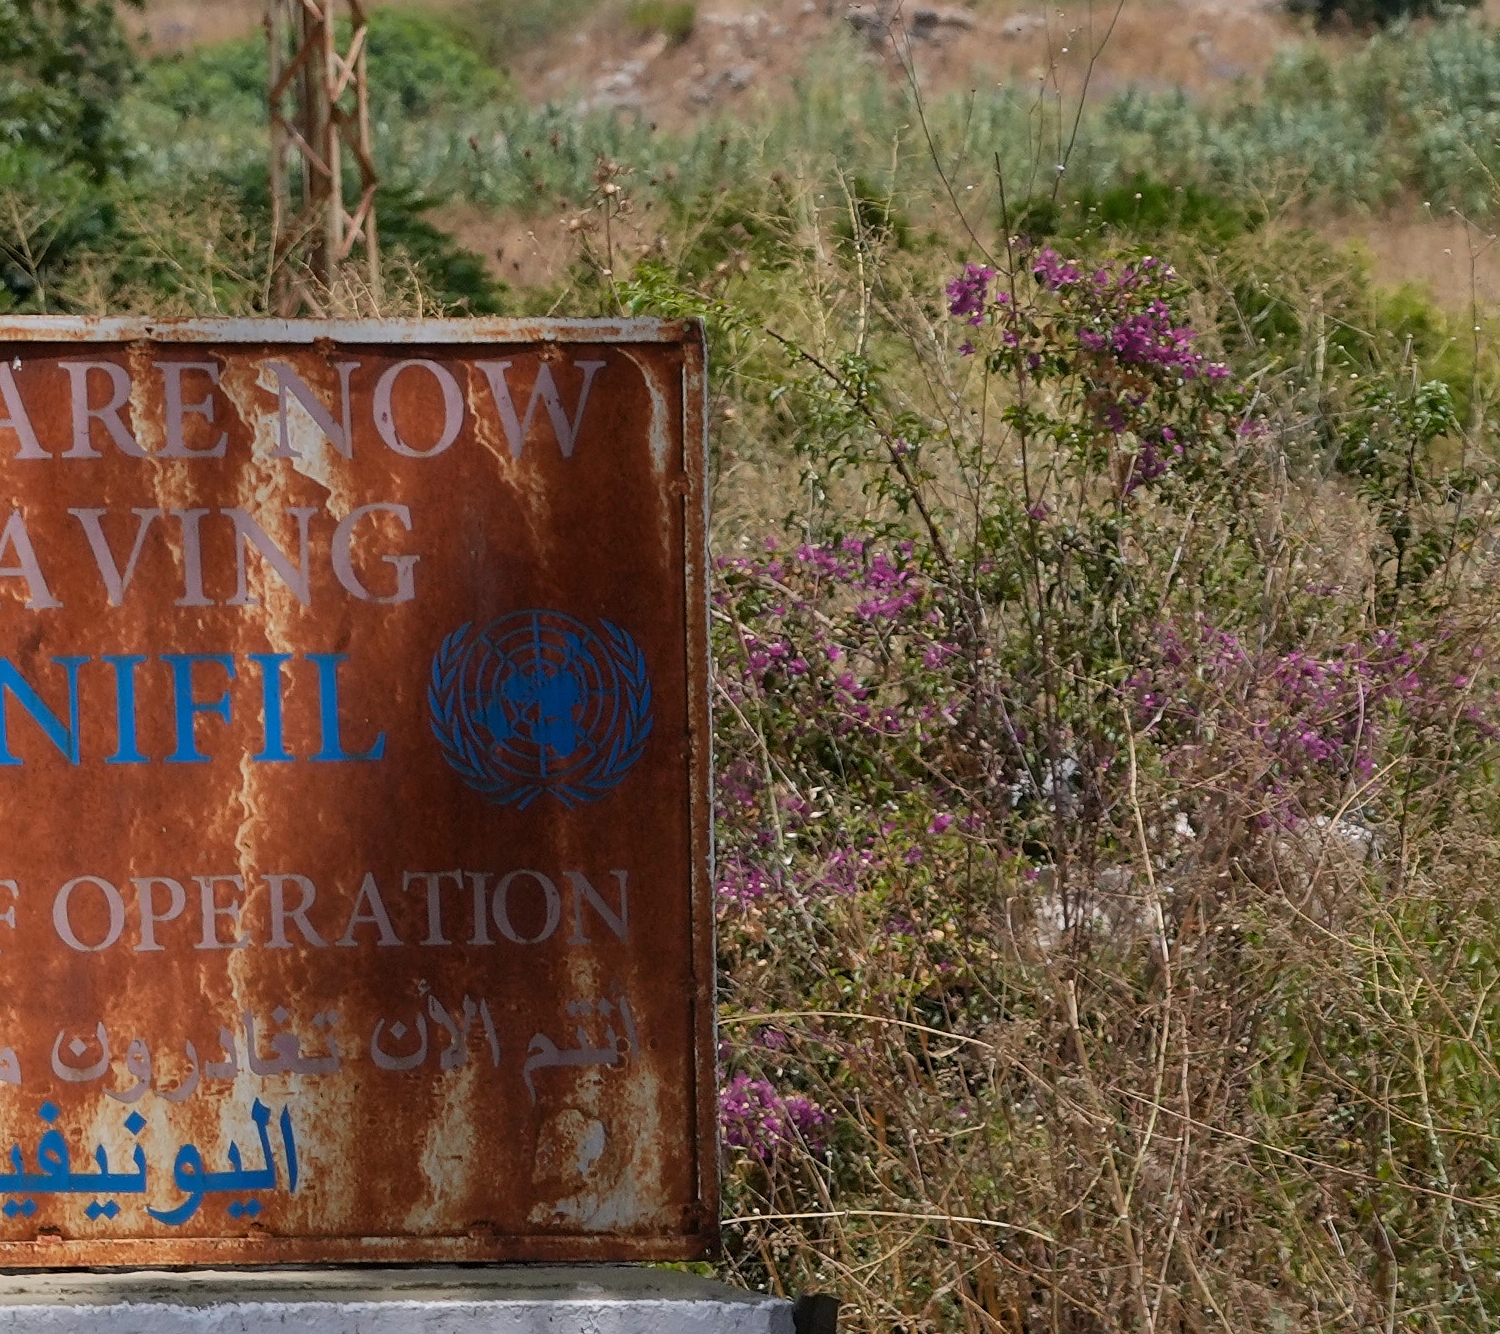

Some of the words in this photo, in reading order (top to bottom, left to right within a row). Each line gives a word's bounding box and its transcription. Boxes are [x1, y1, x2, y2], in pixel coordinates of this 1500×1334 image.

[254, 358, 606, 460] NOW
[52, 868, 630, 952] OPERATION
[51, 1003, 341, 1103] تغادرون
